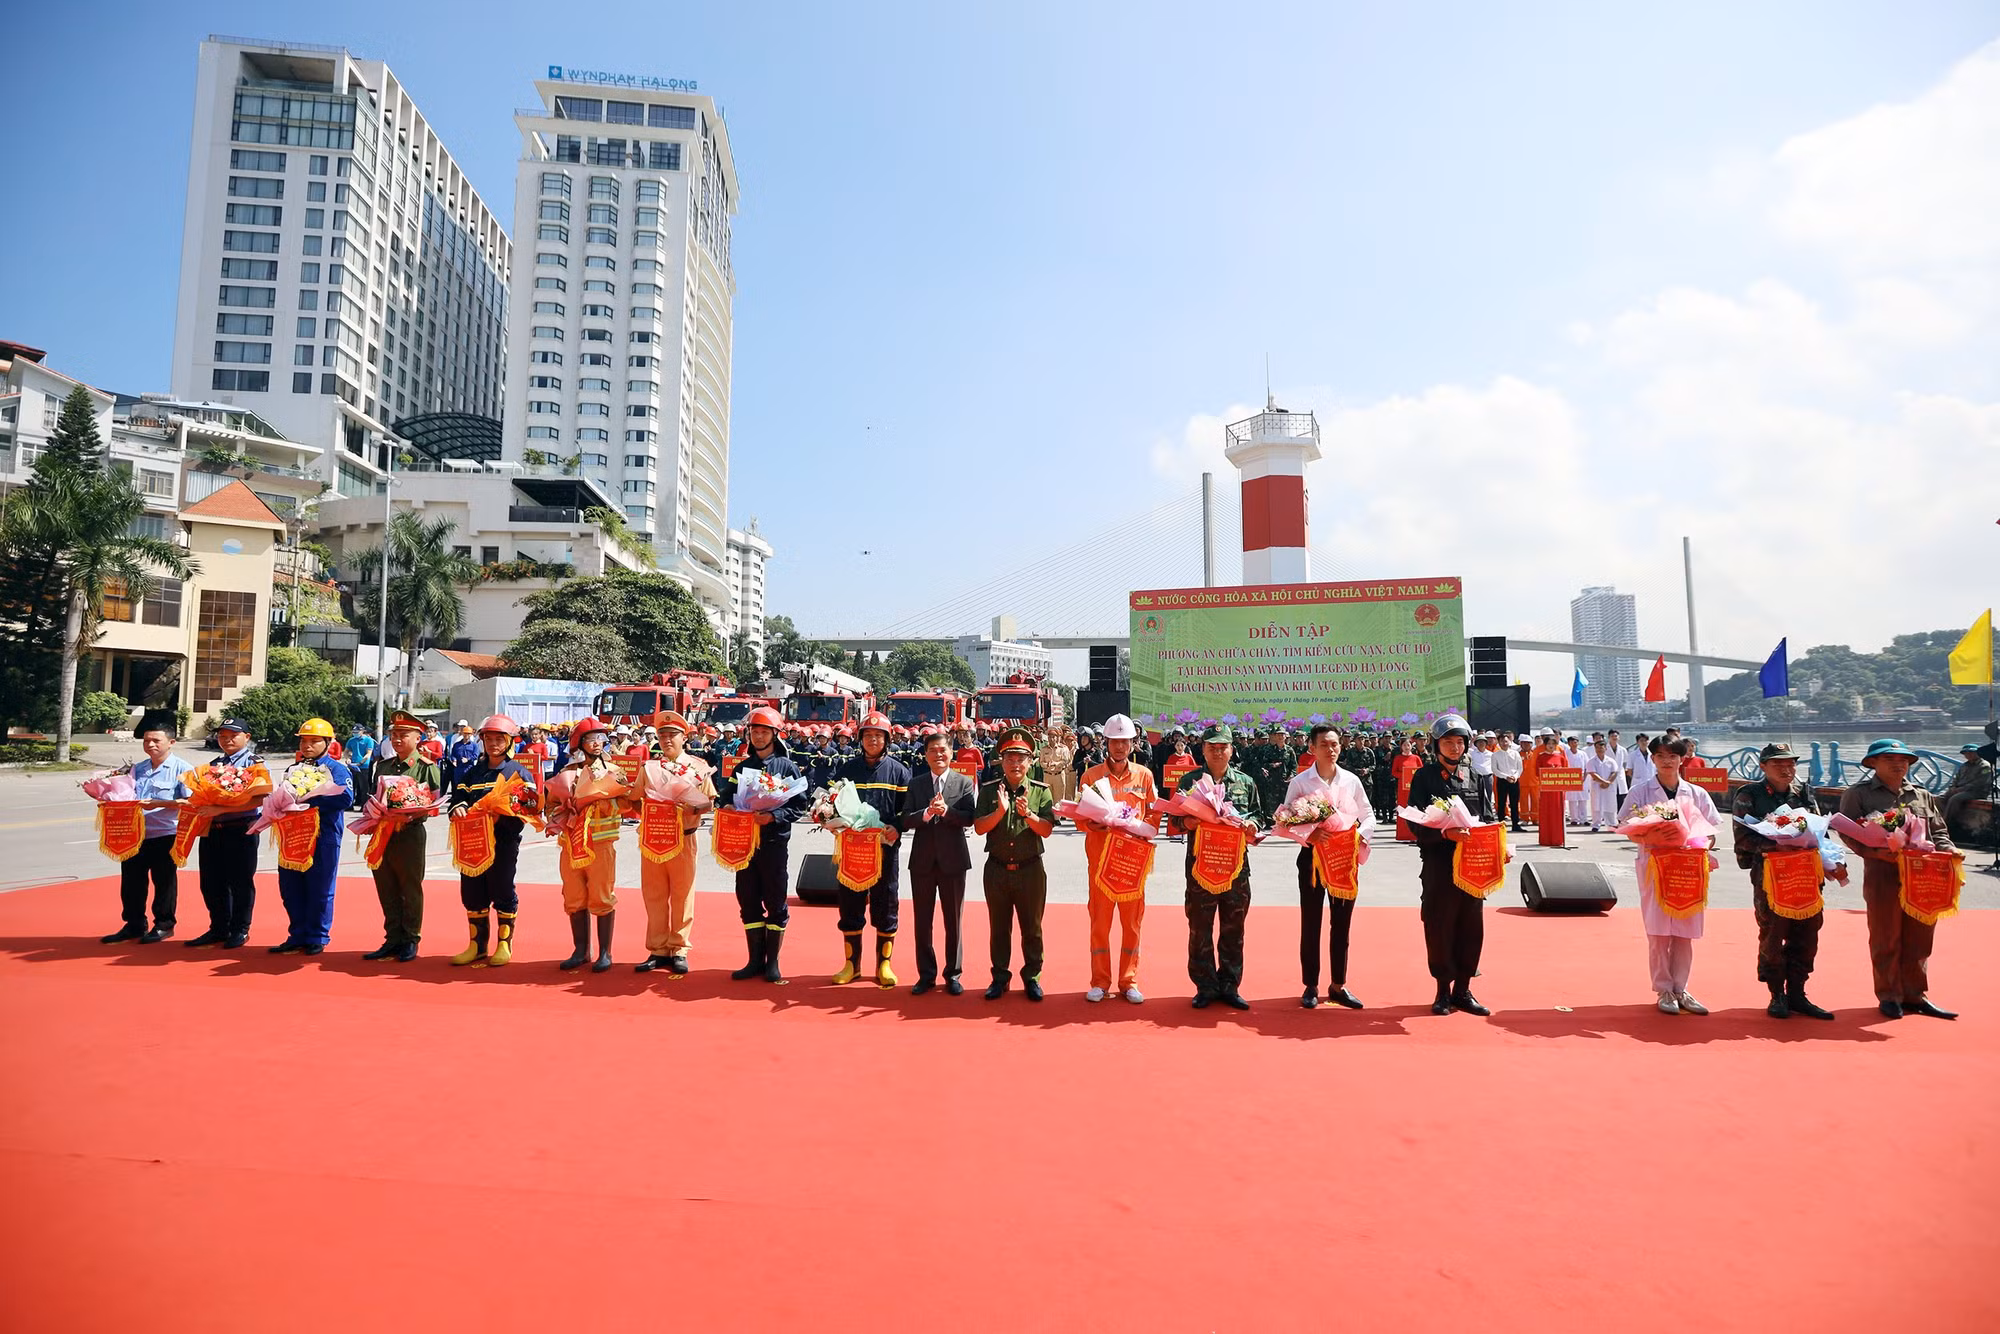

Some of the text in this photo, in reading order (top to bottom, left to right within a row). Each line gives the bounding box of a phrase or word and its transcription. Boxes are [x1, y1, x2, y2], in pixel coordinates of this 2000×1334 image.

[568, 69, 698, 90] WYNDHAM HALONG
[1158, 585, 1429, 605] NƯỚC CỘNG HÒA XÃ HỘI CHỦ NGHĨA VIỆT NAM!
[1248, 620, 1330, 641] DIỄN TẬP
[1158, 650, 1199, 659] PHƯƠNG
[1218, 647, 1246, 658] CHỮA
[1249, 646, 1280, 657] CHÁY,
[1284, 645, 1302, 656] TÌM
[1306, 643, 1332, 656] KIẾM
[1335, 644, 1357, 655] CỨU
[1360, 645, 1385, 657] NẠN,
[1389, 643, 1411, 654] CỨU
[1414, 642, 1431, 656] HỘ
[1178, 662, 1409, 677] TẠI KHÁCH SẠN WYNDHAM LEGEND HẠ LONG
[1171, 681, 1205, 692] KHÁCH
[1209, 682, 1228, 694] SẠN
[1276, 680, 1289, 691] VÀ
[1292, 681, 1314, 691] KHU
[1318, 680, 1338, 693] VỰC
[1342, 675, 1368, 690] BIỂN
[1396, 679, 1417, 692] LỰC
